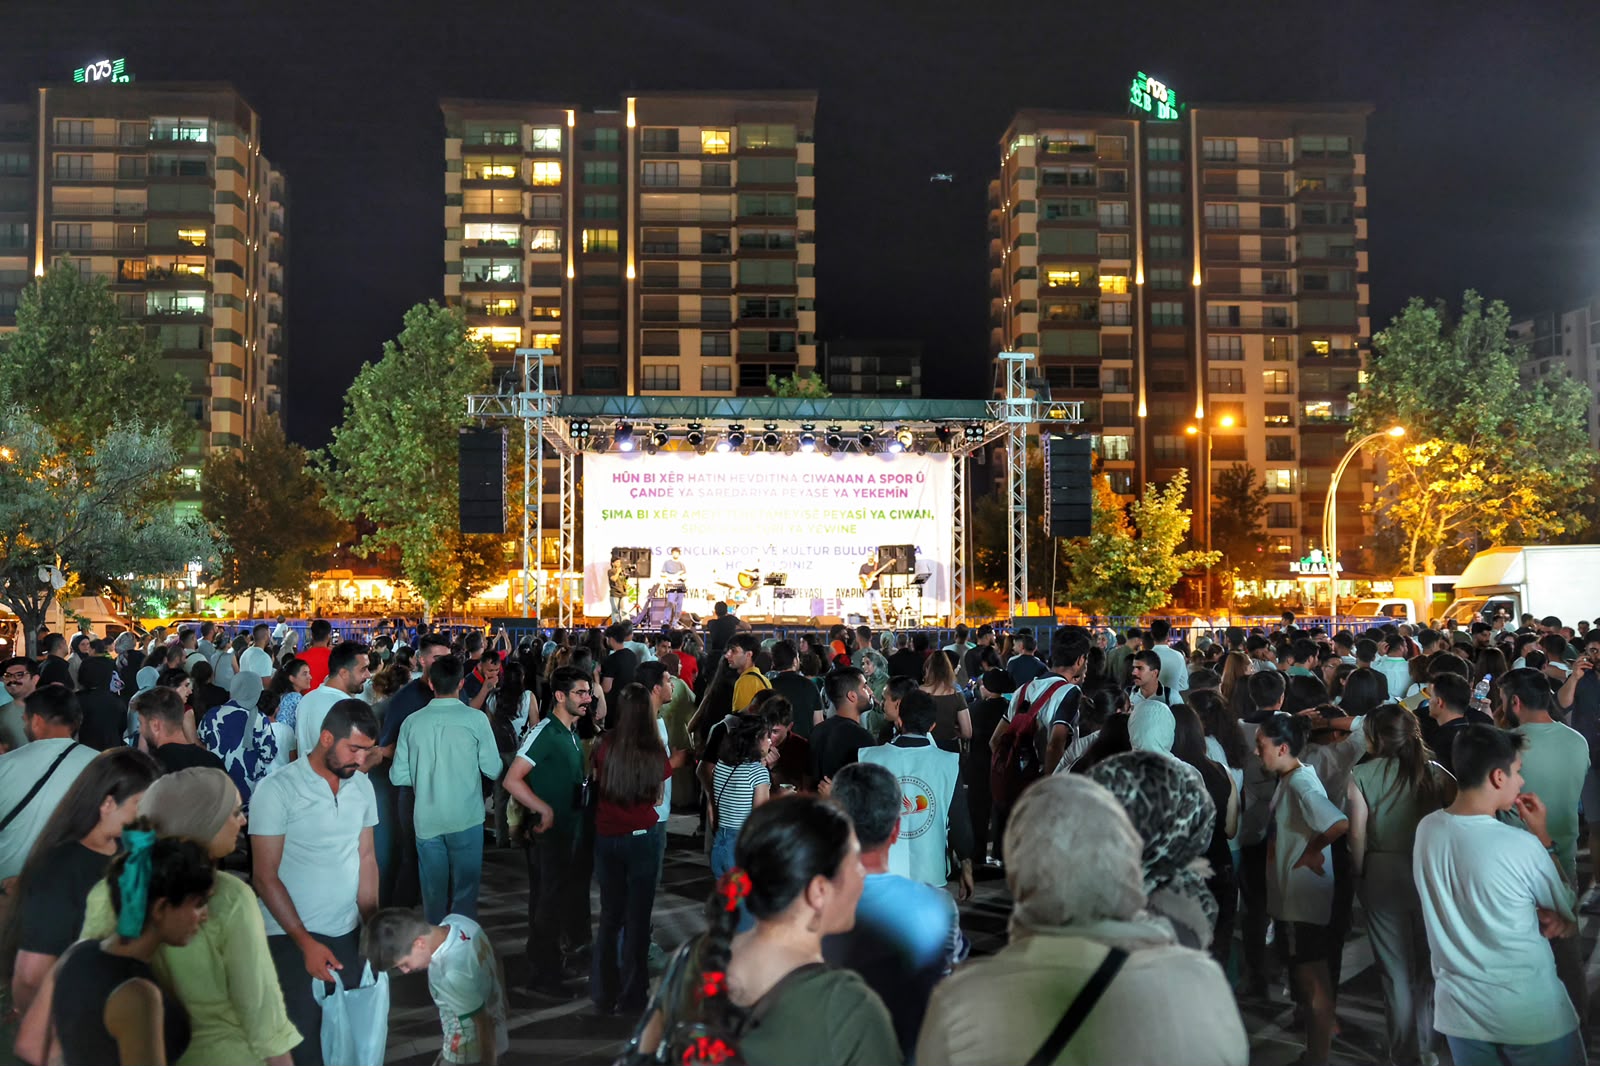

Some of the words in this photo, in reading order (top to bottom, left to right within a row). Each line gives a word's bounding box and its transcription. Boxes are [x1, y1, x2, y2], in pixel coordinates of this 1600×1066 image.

[612, 470, 640, 483] HÛN
[643, 473, 656, 483] BI
[659, 470, 685, 483] XÊR
[802, 473, 864, 484] CIWANAN
[867, 474, 877, 484] A
[880, 474, 913, 484] SPOR
[916, 470, 925, 484] Û
[678, 488, 694, 497] YA
[833, 488, 849, 498] YA
[637, 509, 649, 519] BI
[870, 510, 887, 519] YA
[1290, 562, 1343, 572] MUALA
